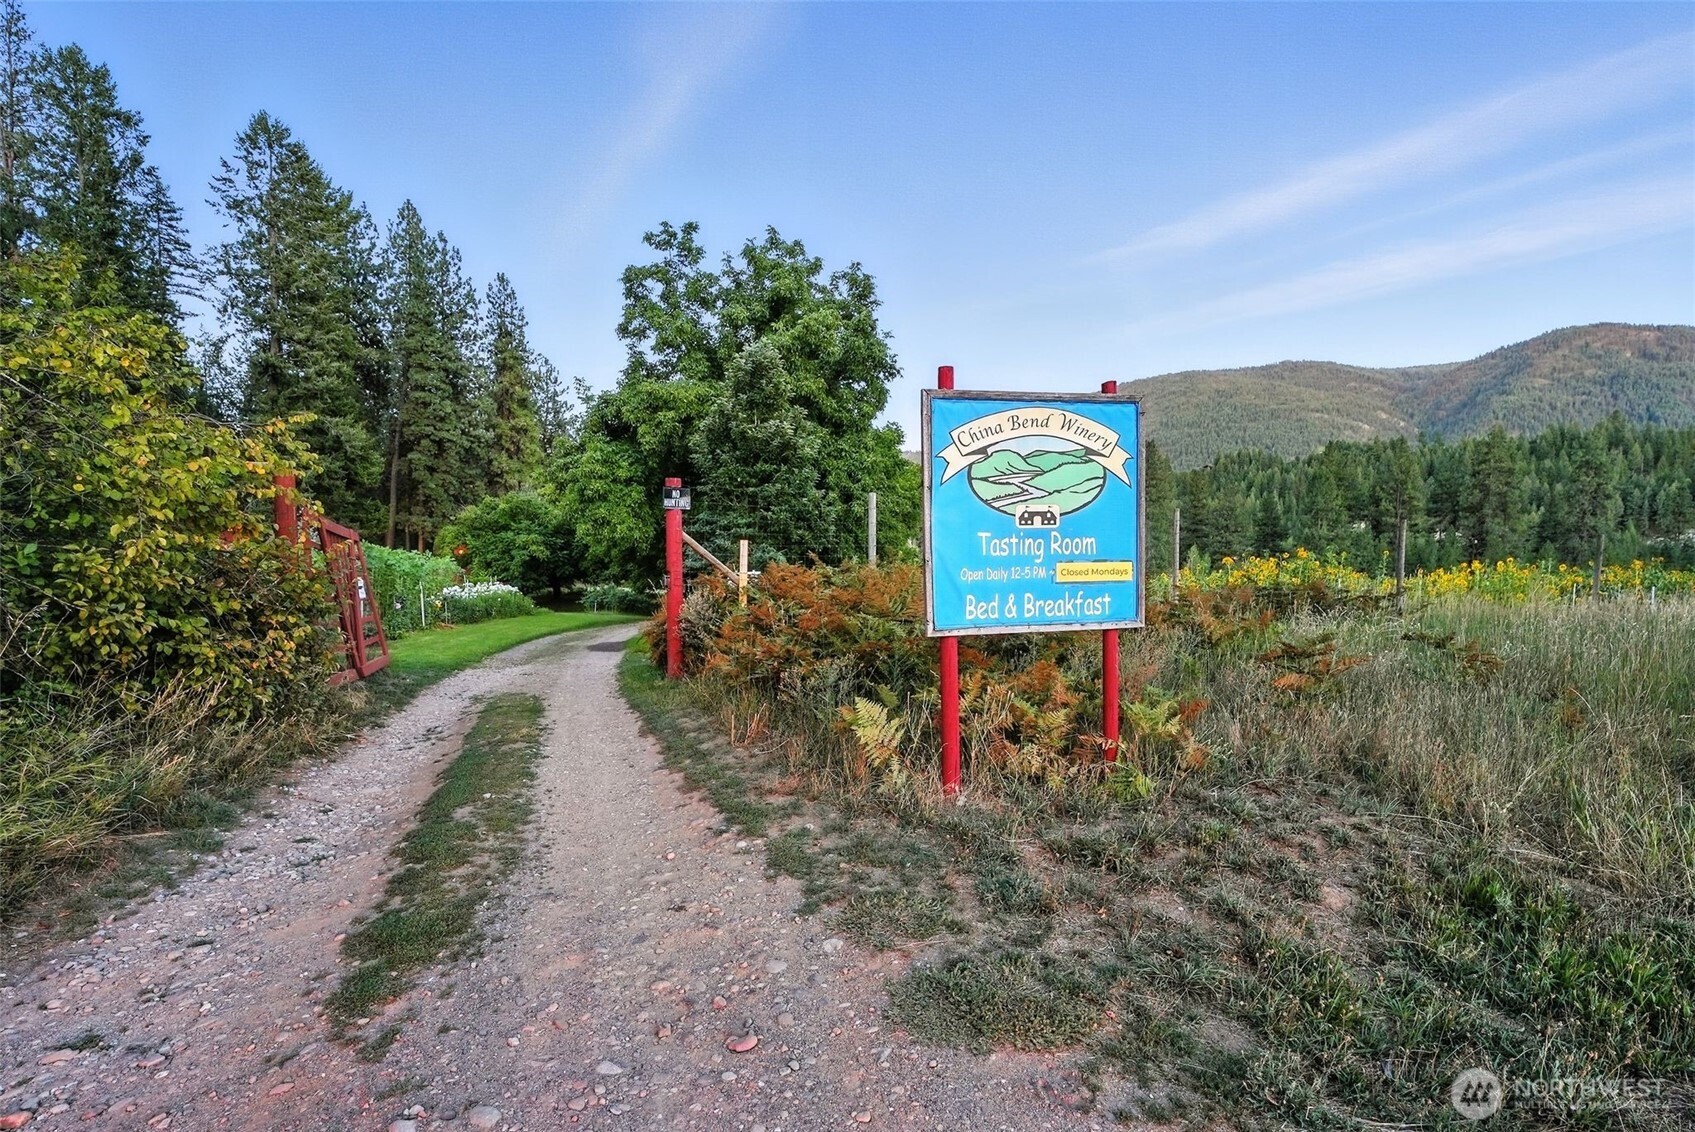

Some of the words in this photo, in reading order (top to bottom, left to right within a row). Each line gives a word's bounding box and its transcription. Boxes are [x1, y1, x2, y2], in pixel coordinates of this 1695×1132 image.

[957, 423, 1004, 447] China
[1007, 413, 1054, 431] Bend
[1058, 412, 1113, 451] Winery
[664, 498, 689, 507] HUNTING
[672, 489, 681, 498] NO
[977, 531, 1045, 563] Tasting
[1050, 531, 1097, 555] Room
[960, 567, 984, 584] Open
[986, 566, 1009, 583] Daily
[1011, 566, 1031, 580] 12-5
[1033, 566, 1047, 578] PM
[1060, 567, 1090, 577] Closed
[1091, 566, 1129, 577] Mondays
[965, 593, 999, 620] Bed
[1004, 592, 1018, 618] &
[1023, 590, 1112, 618] Breakfast
